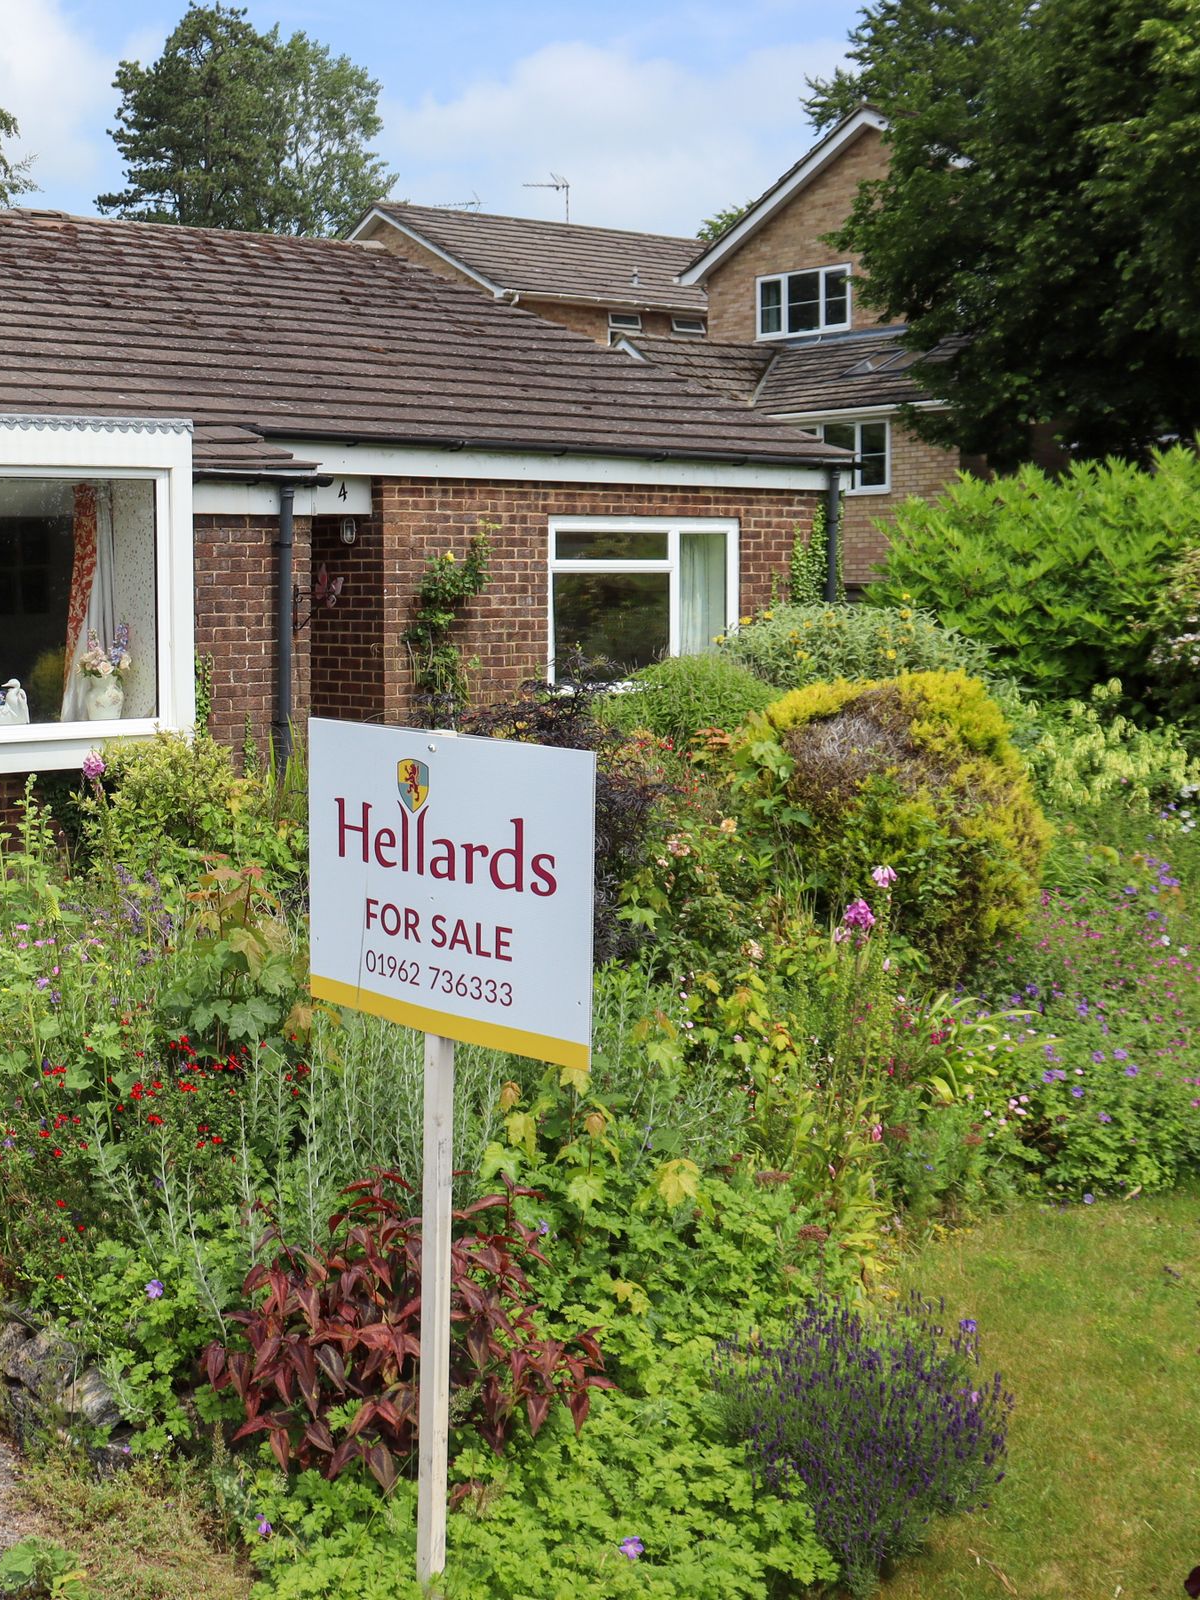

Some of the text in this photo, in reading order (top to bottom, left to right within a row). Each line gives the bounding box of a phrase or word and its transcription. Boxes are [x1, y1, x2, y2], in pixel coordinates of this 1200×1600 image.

[337, 481, 349, 503] 4
[334, 797, 558, 897] Hellards
[365, 897, 513, 962] FOR SALE
[365, 949, 513, 1007] 01962 736333
